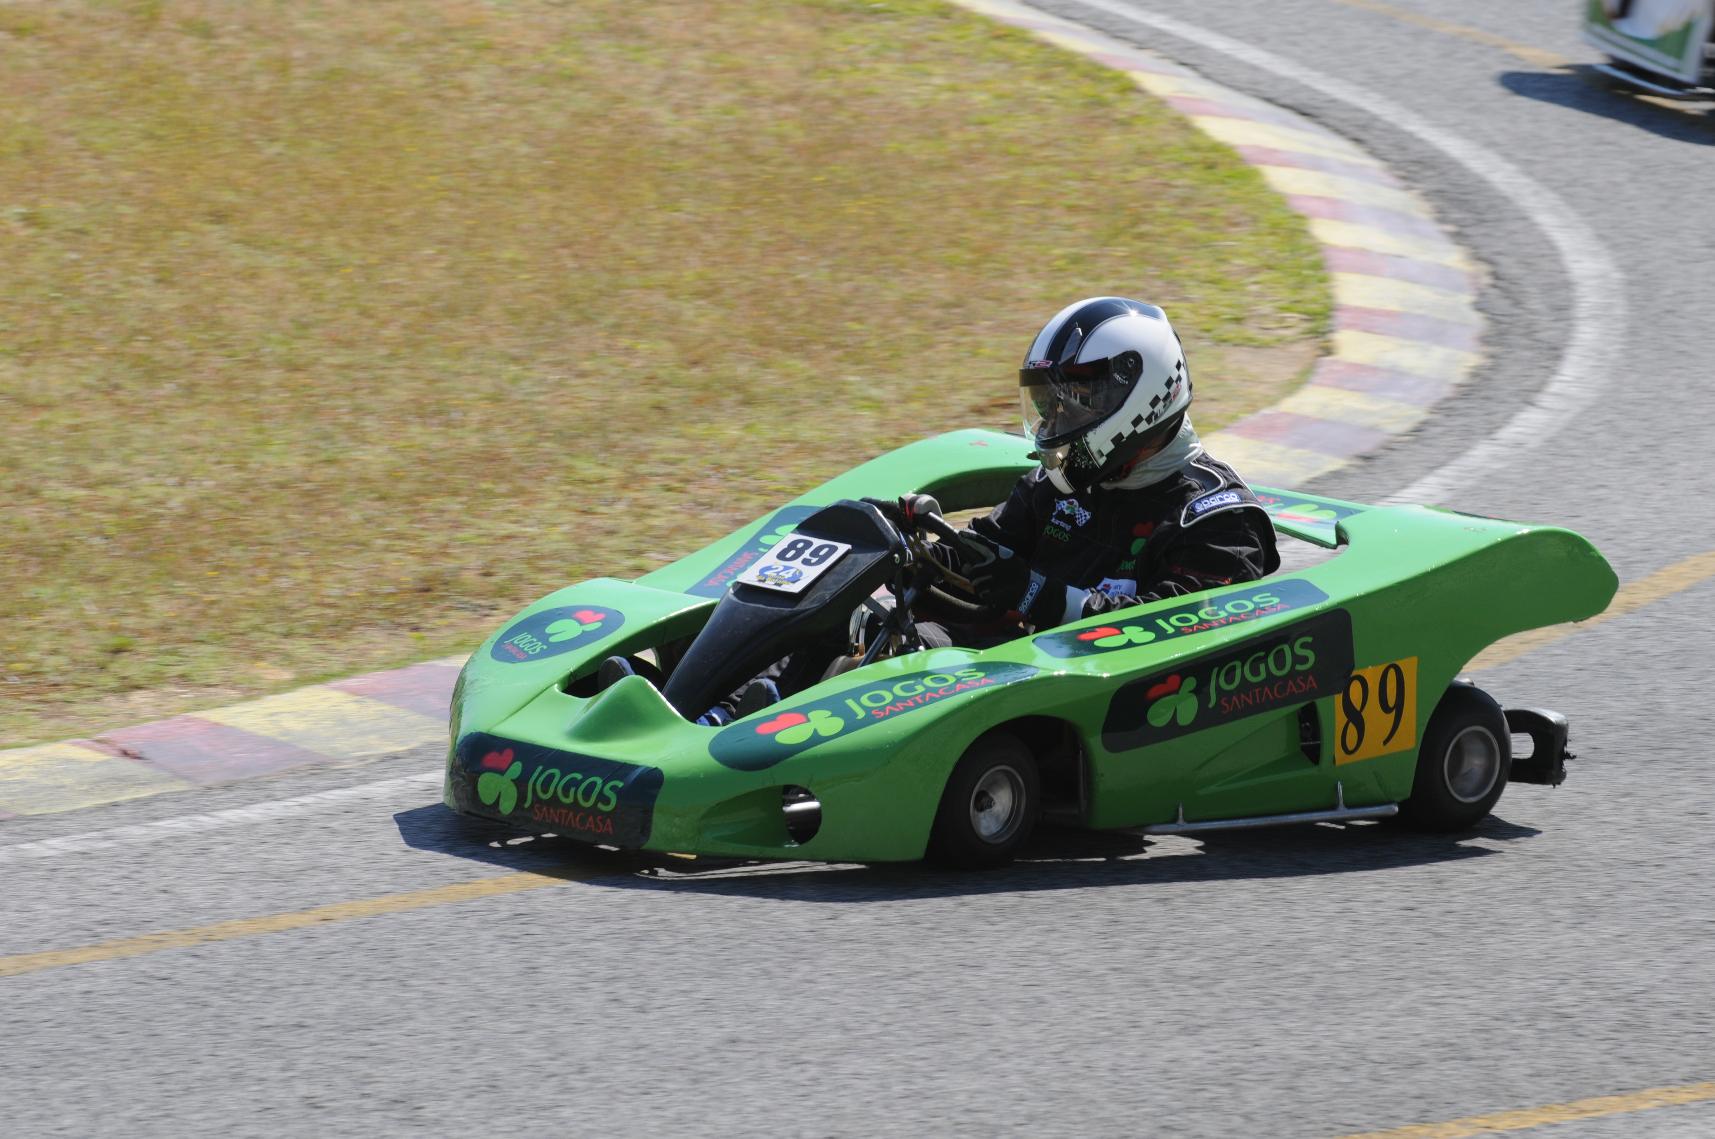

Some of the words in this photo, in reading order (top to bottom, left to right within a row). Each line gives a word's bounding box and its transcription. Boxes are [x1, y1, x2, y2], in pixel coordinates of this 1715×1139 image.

[1194, 491, 1237, 512] sparco
[763, 565, 796, 578] 24
[776, 538, 838, 567] 89
[1155, 592, 1281, 634] JOGOS
[1180, 603, 1290, 635] SANTACASA
[504, 632, 547, 654] JOGOS
[1207, 636, 1316, 708] JOGOS
[845, 668, 986, 720] JOGOS
[871, 677, 997, 719] SANTACASA
[1220, 674, 1318, 714] SANTACASA
[1340, 663, 1405, 756] 89
[524, 765, 624, 812] JOGOS
[533, 804, 614, 834] SANTACASA
